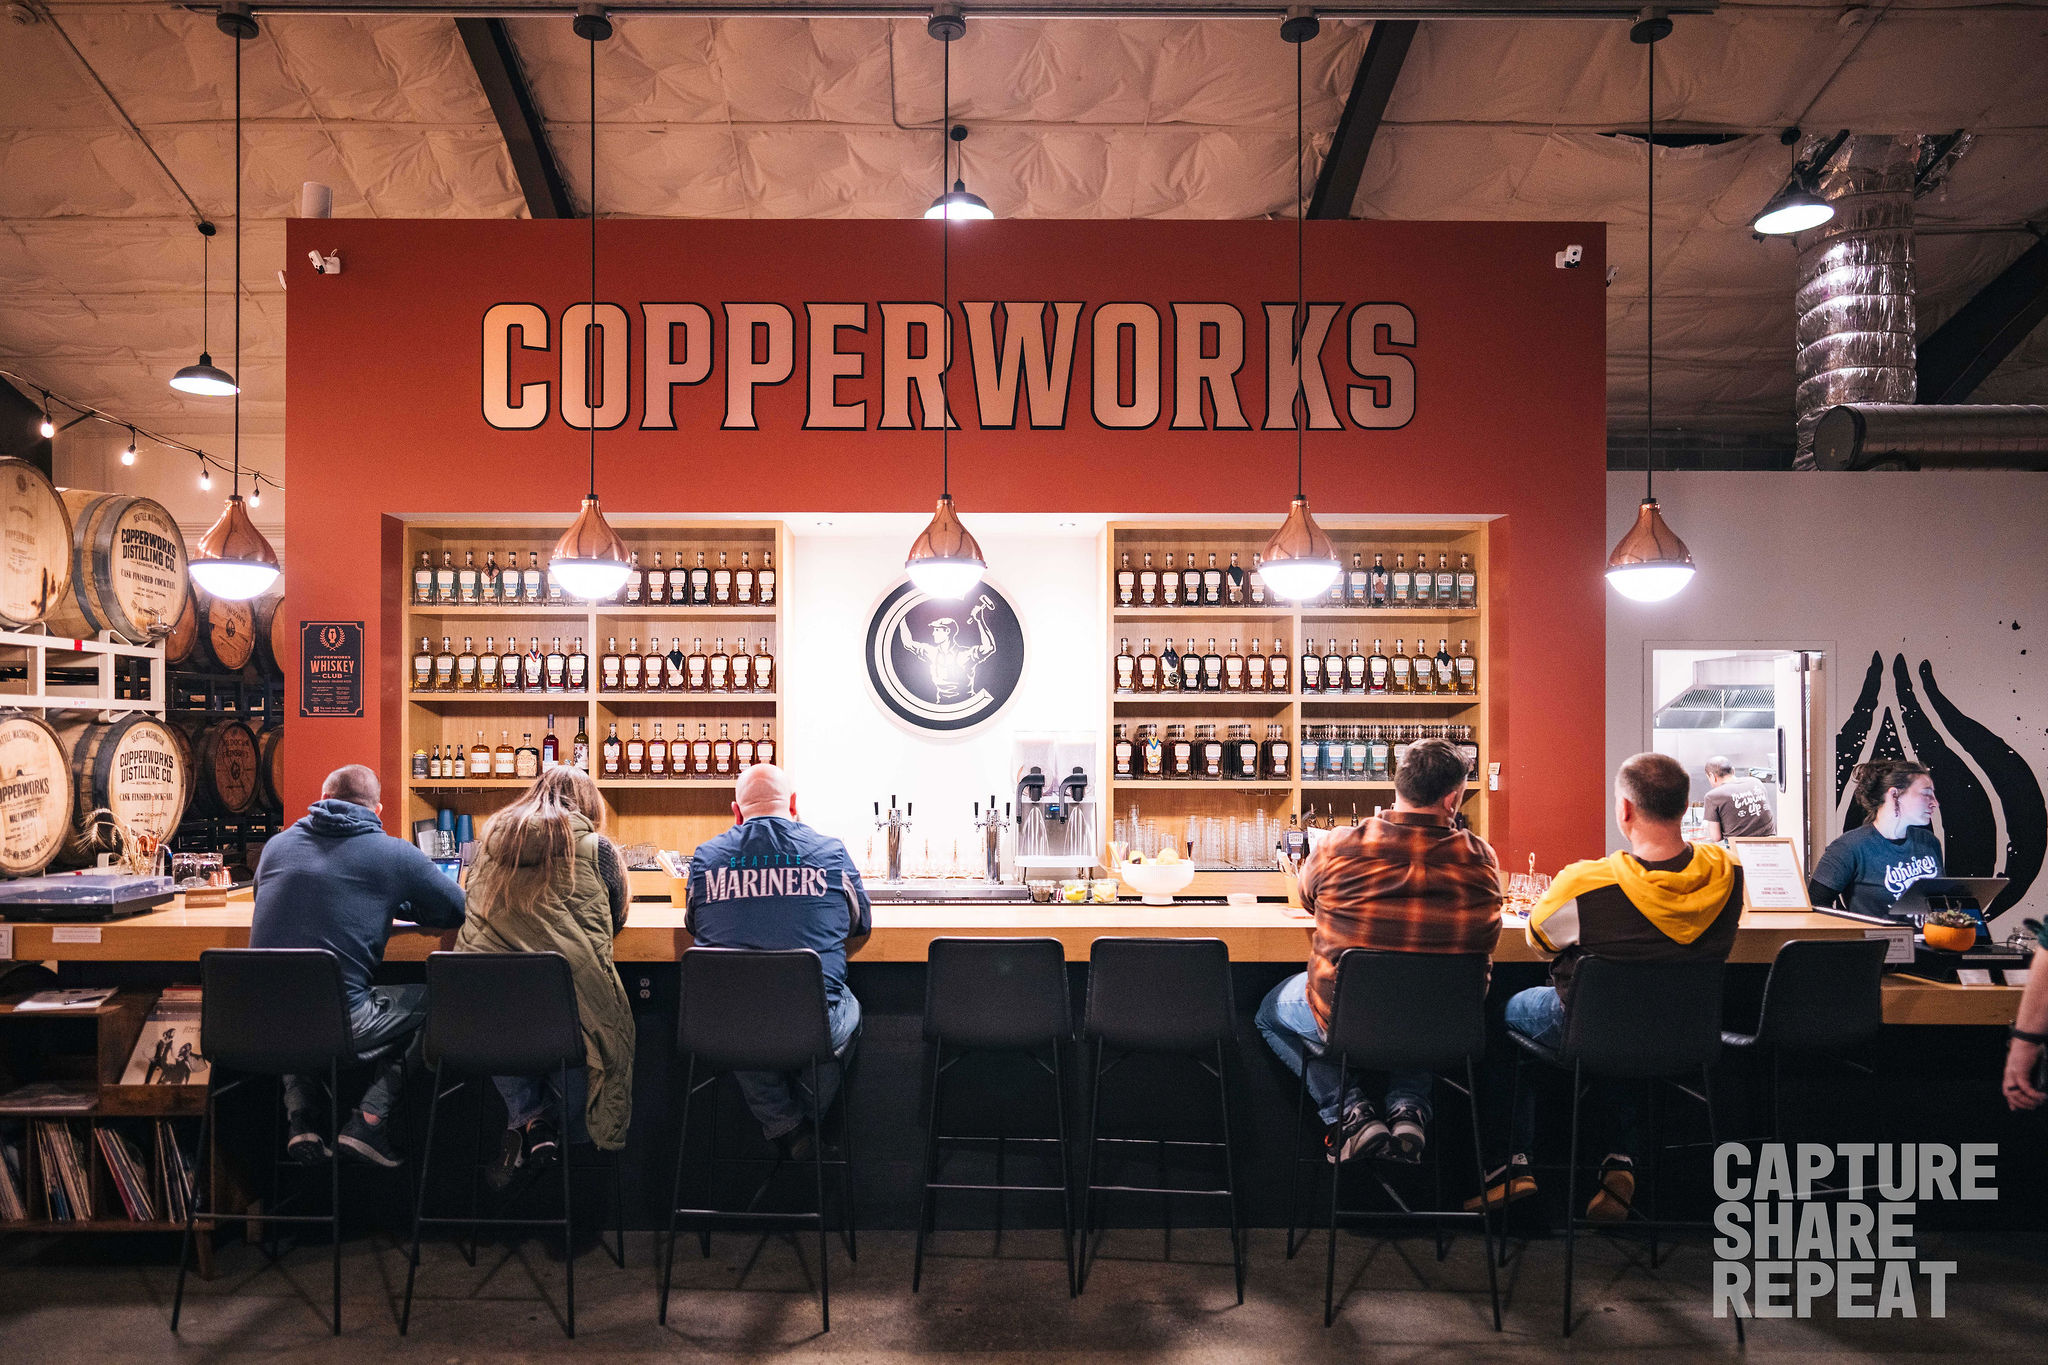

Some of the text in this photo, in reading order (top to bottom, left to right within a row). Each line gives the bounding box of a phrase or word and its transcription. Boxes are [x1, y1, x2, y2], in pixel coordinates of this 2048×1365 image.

[482, 302, 1417, 430] COPPERWORKS
[121, 528, 177, 559] COPPERWORKS
[122, 544, 164, 567] DISTILLING
[165, 555, 176, 574] CO.
[310, 660, 354, 674] WHISKEY
[120, 750, 174, 769] COPPERWORKS
[121, 765, 174, 784] DISTILLING CO.
[730, 854, 801, 868] SEATTLE
[1884, 855, 1938, 893] Whiskey
[704, 866, 828, 904] MARINERS
